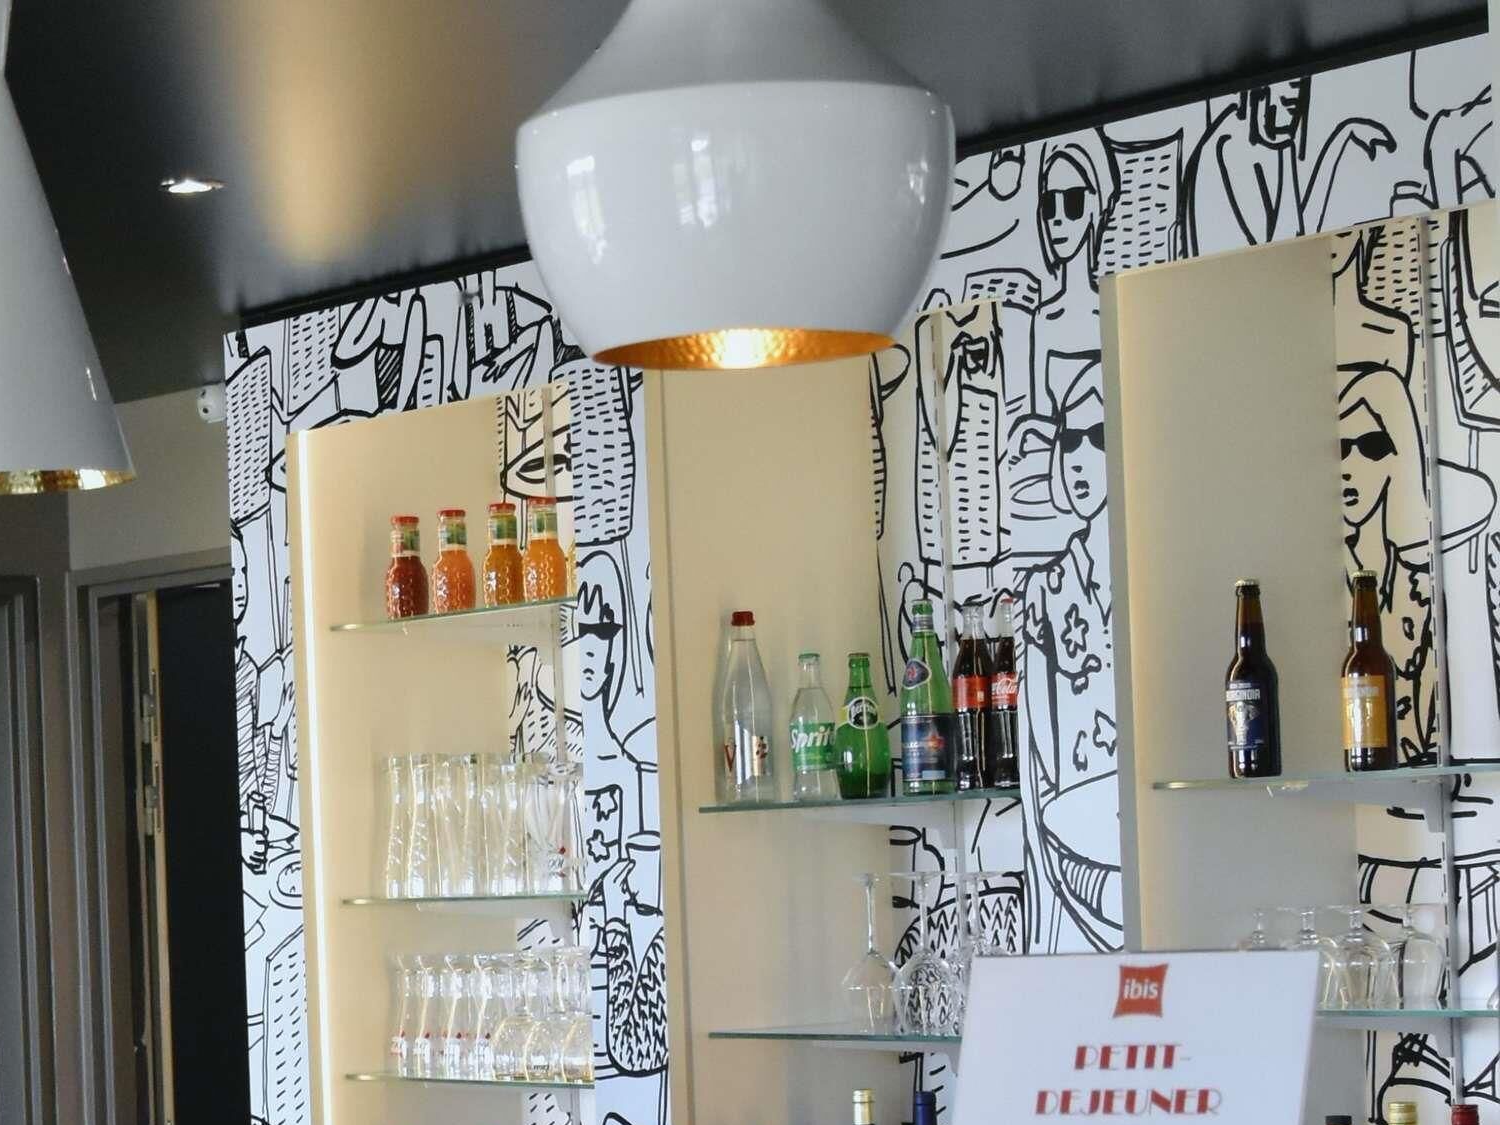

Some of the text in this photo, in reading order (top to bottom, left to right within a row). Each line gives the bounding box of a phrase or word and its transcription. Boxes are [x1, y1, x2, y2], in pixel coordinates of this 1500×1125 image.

[1123, 979, 1159, 999] ibis
[1074, 1043, 1192, 1070] PETIT-
[1035, 1088, 1223, 1116] DEJEUNER
